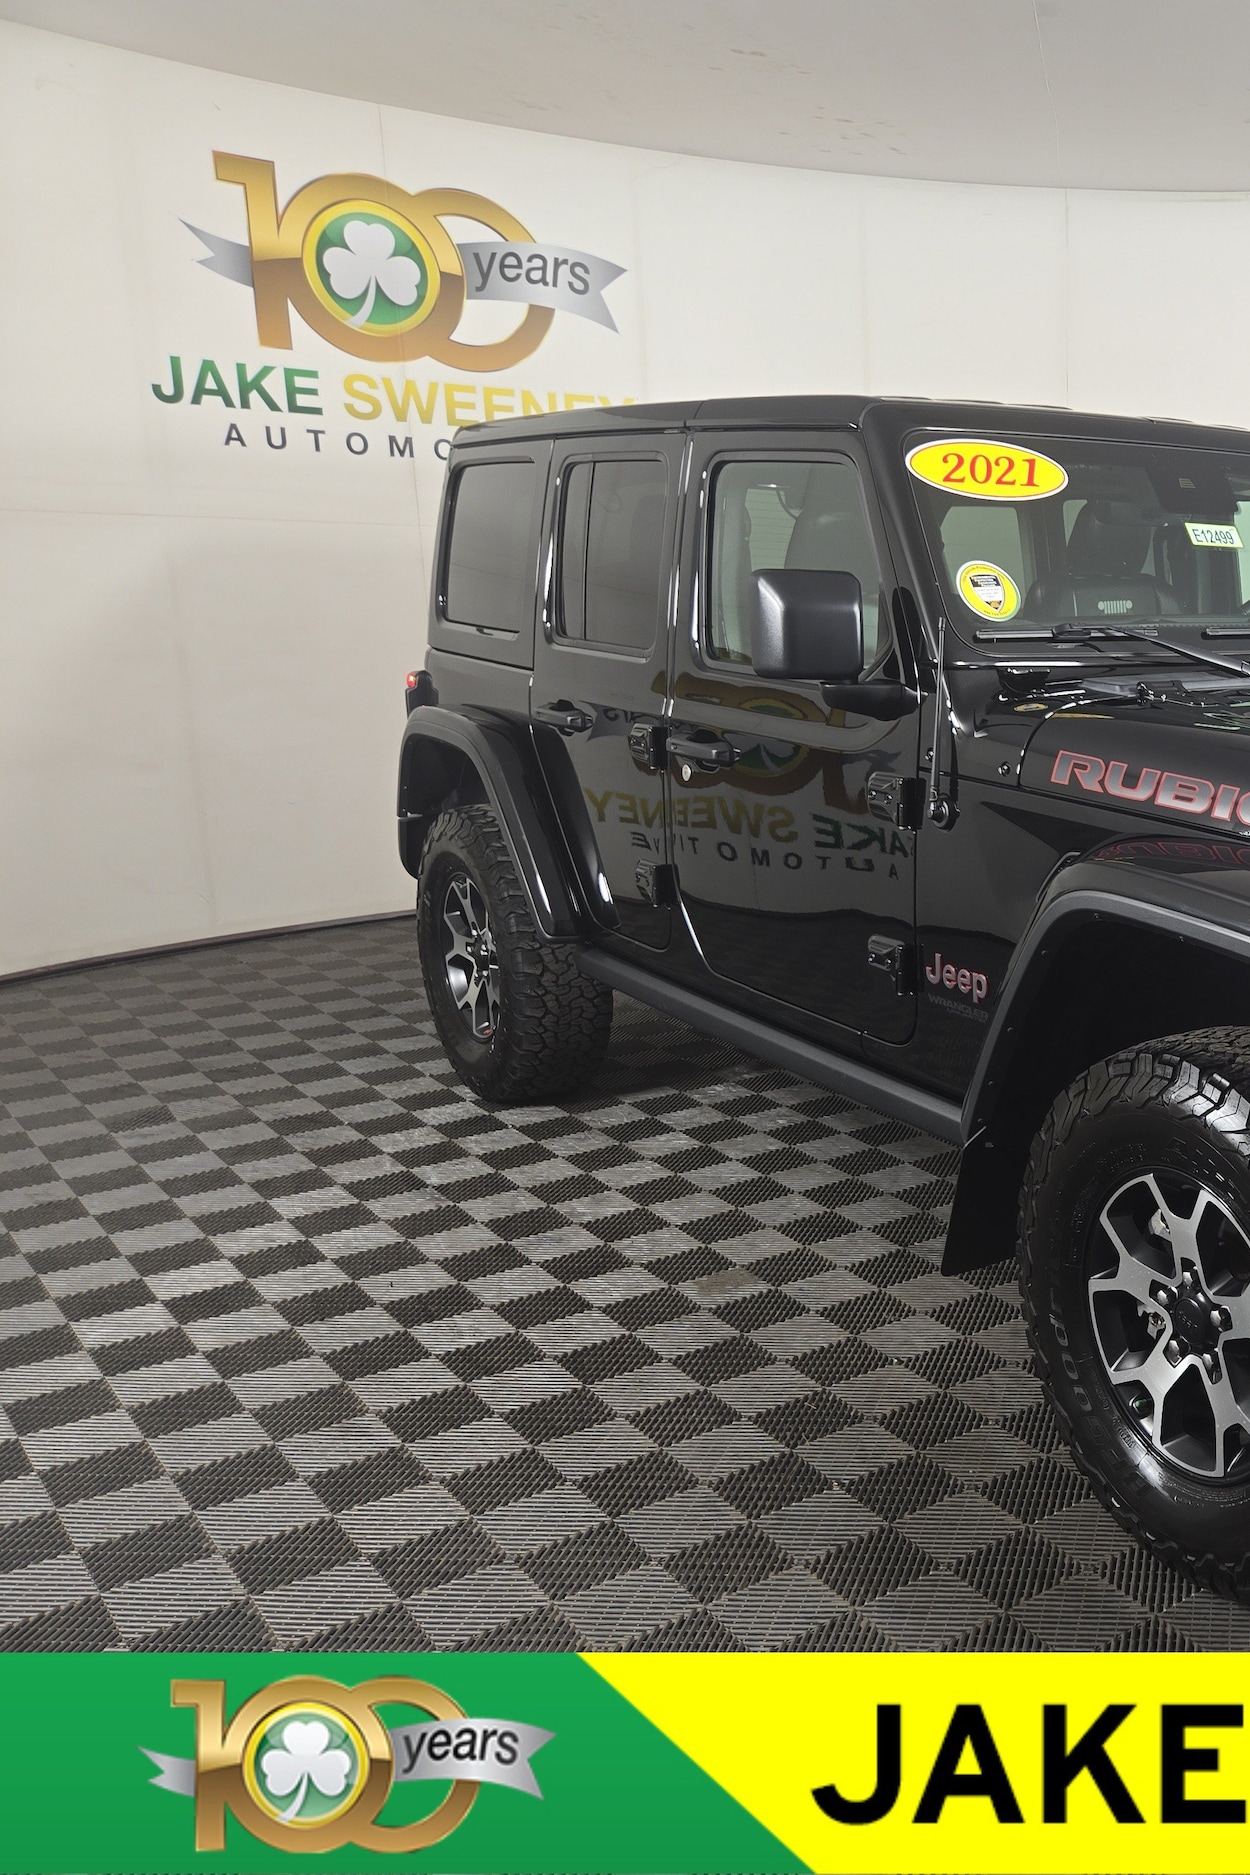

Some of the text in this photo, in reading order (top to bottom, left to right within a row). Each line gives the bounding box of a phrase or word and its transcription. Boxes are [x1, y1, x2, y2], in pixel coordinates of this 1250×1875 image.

[473, 250, 592, 296] years
[151, 355, 636, 428] JAKE SWEEN
[942, 452, 1040, 488] 2021
[1192, 528, 1235, 545] E12499
[925, 952, 988, 1004] Jeep
